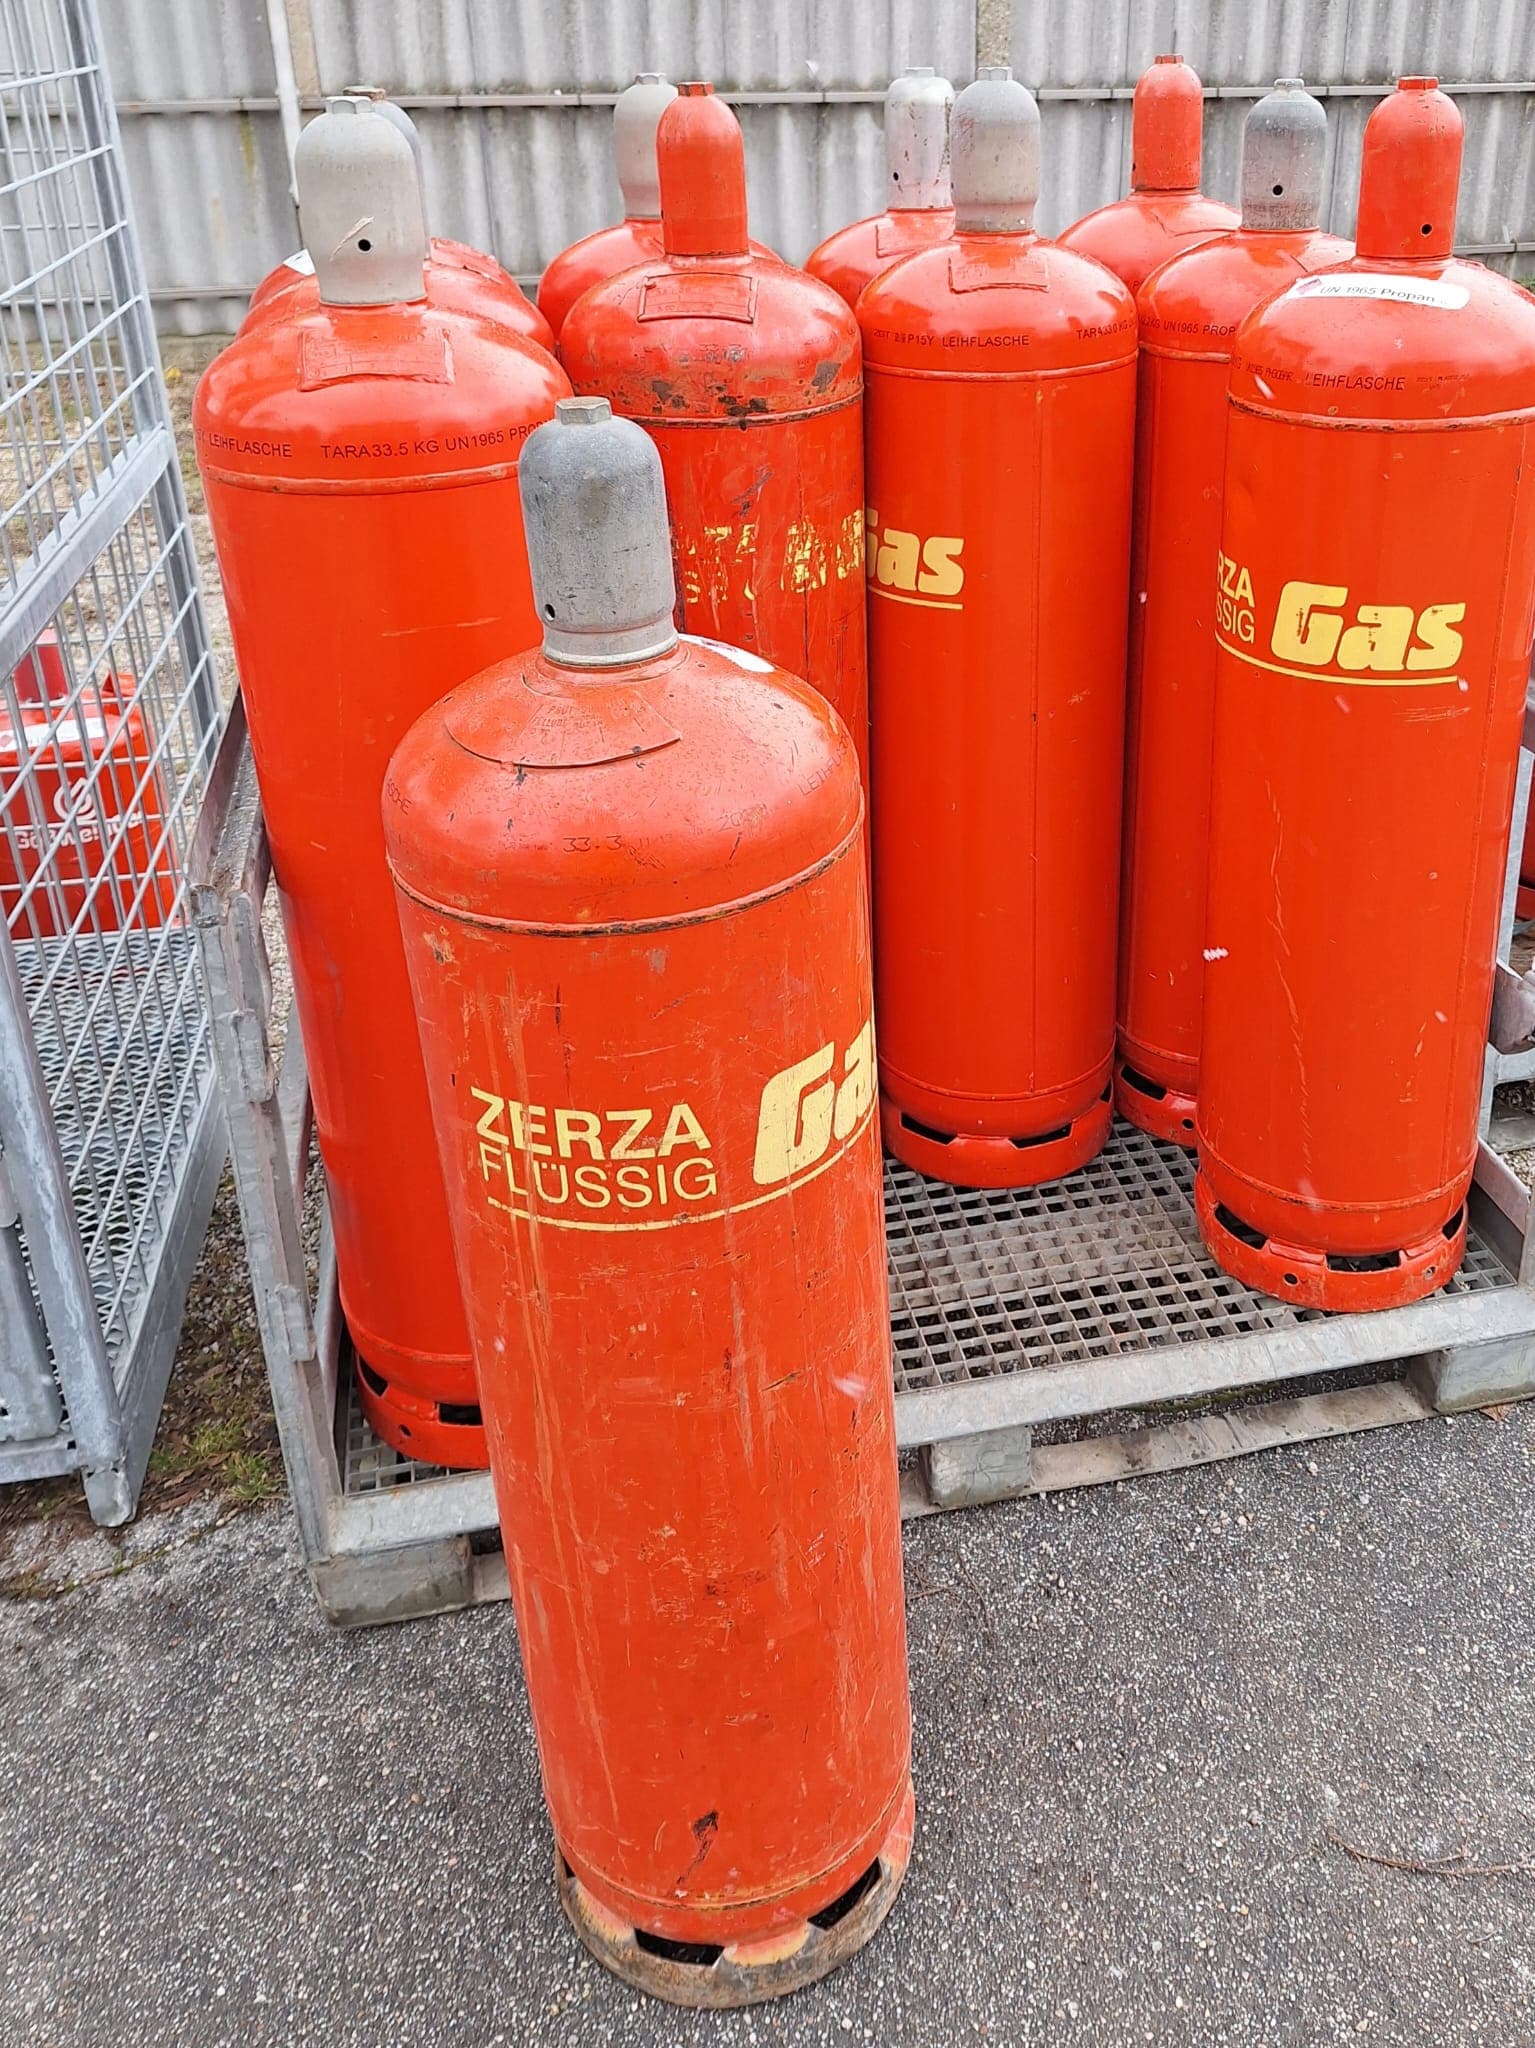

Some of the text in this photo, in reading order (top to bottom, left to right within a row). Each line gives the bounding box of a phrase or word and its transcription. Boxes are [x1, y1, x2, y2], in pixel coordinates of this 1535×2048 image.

[1319, 286, 1435, 303] UN 1965 Propan
[942, 335, 1030, 348] LEIHFLASCHE
[1163, 322, 1199, 334] UN1965
[209, 433, 293, 458] LEIHFLASCHE
[414, 439, 440, 455] KG
[445, 430, 505, 452] UN1965
[1270, 580, 1467, 672] Gas
[470, 1085, 713, 1162] ZERZA
[479, 1142, 719, 1210] FLÜSSIG
